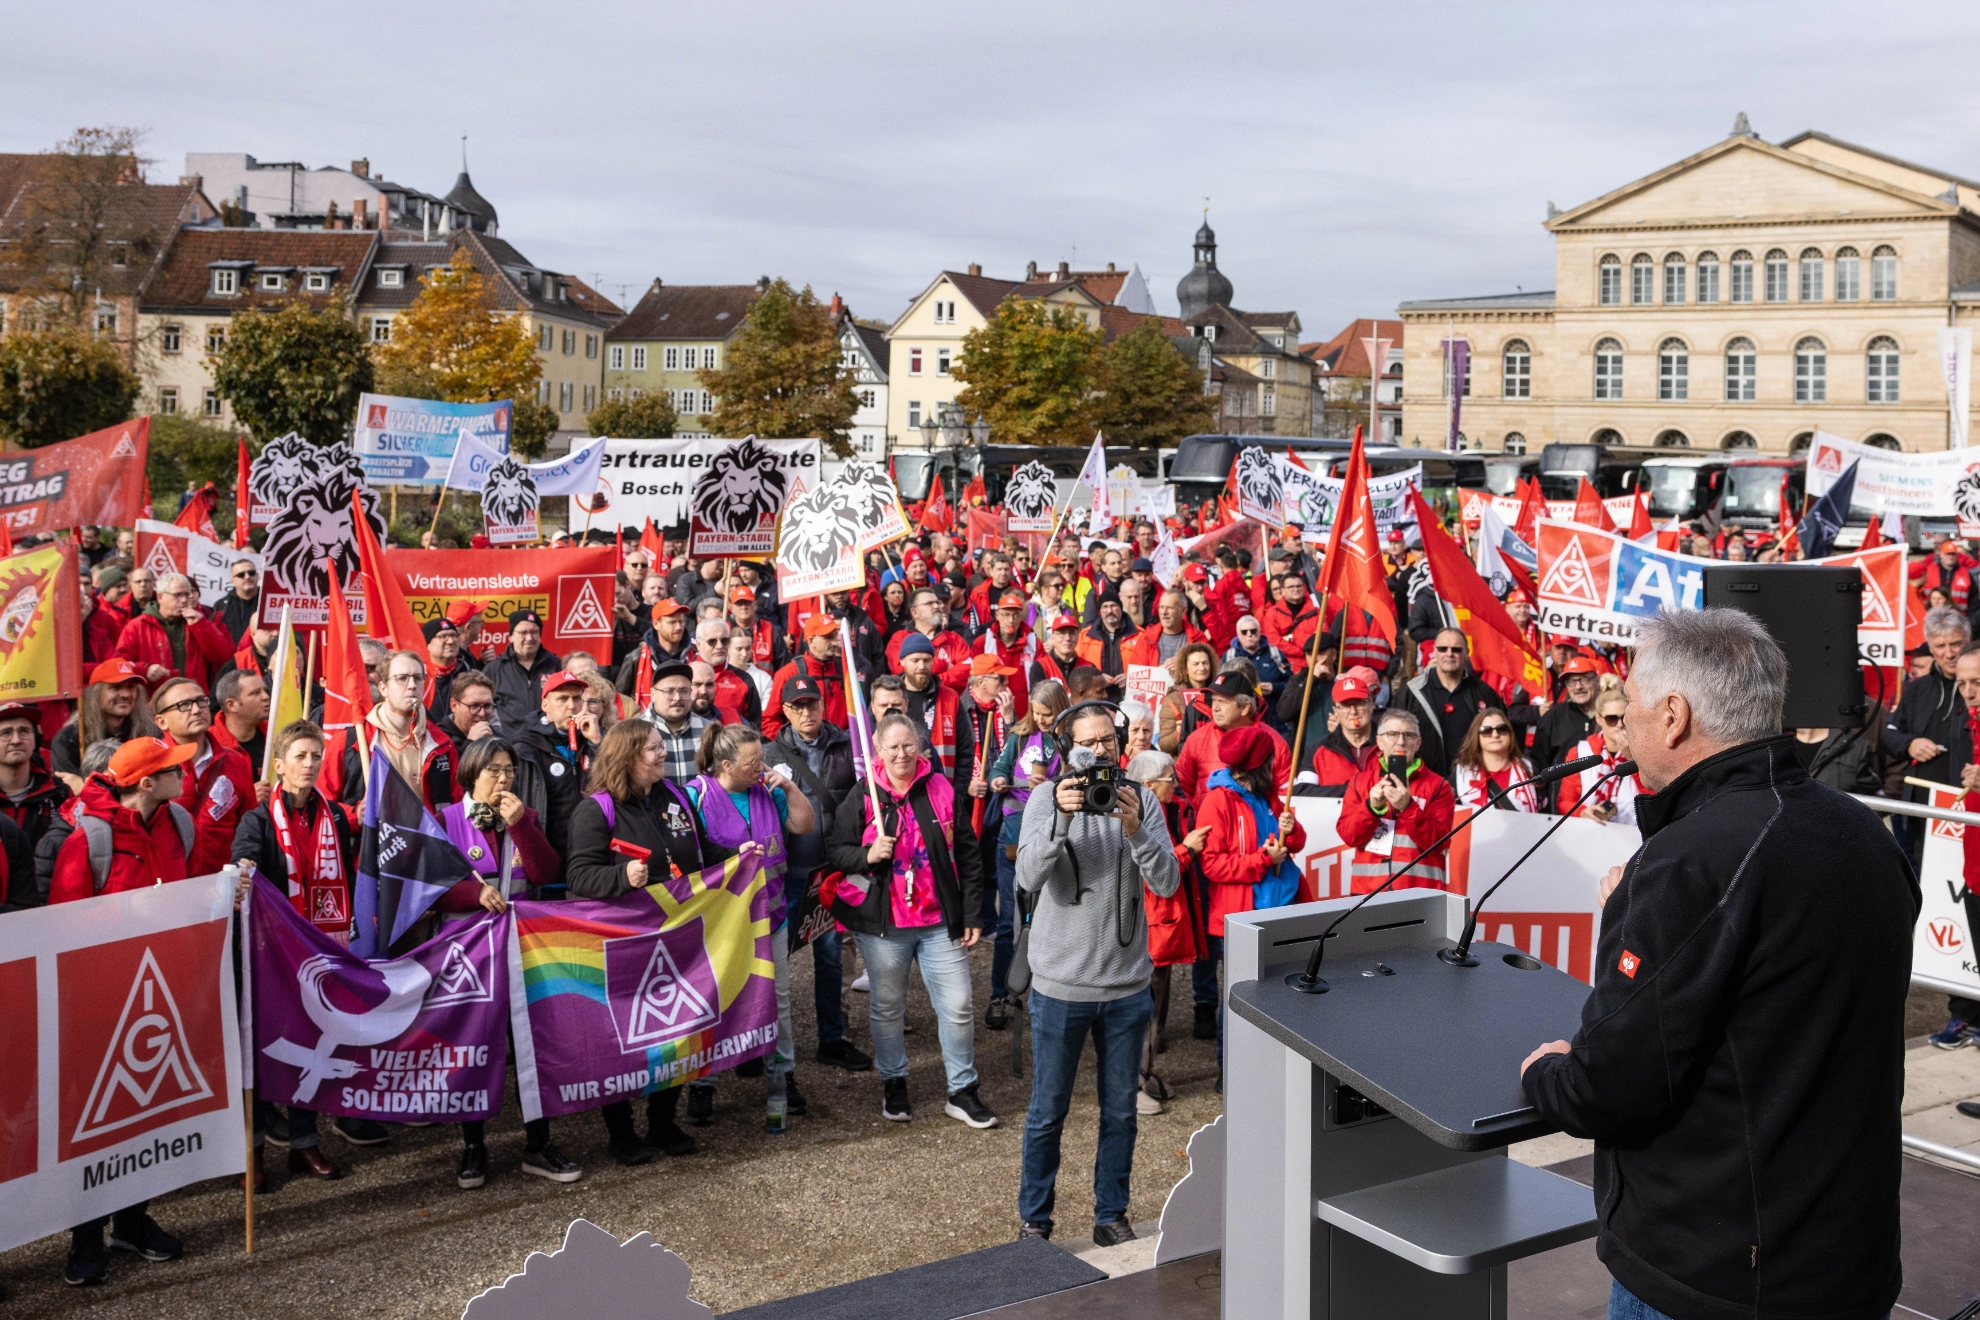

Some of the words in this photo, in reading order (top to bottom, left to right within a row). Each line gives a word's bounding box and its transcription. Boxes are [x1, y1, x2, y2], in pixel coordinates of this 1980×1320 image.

[0, 475, 63, 504] TRAG
[621, 481, 682, 495] Bosch
[1858, 480, 1933, 498] Healthineers
[1878, 473, 1933, 486] SIEMENS
[697, 533, 772, 543] BAYERN:STABIL
[750, 543, 771, 551] ALLES
[407, 573, 539, 590] Vertrauensleute
[1929, 921, 1961, 948] VL
[369, 1043, 489, 1071] VIELFÄLTIG
[374, 1069, 449, 1091] STARK
[559, 1081, 600, 1102] WIR
[604, 1069, 650, 1096] SIND
[341, 1087, 489, 1114] SOLIDARISCH
[82, 1132, 203, 1191] München
